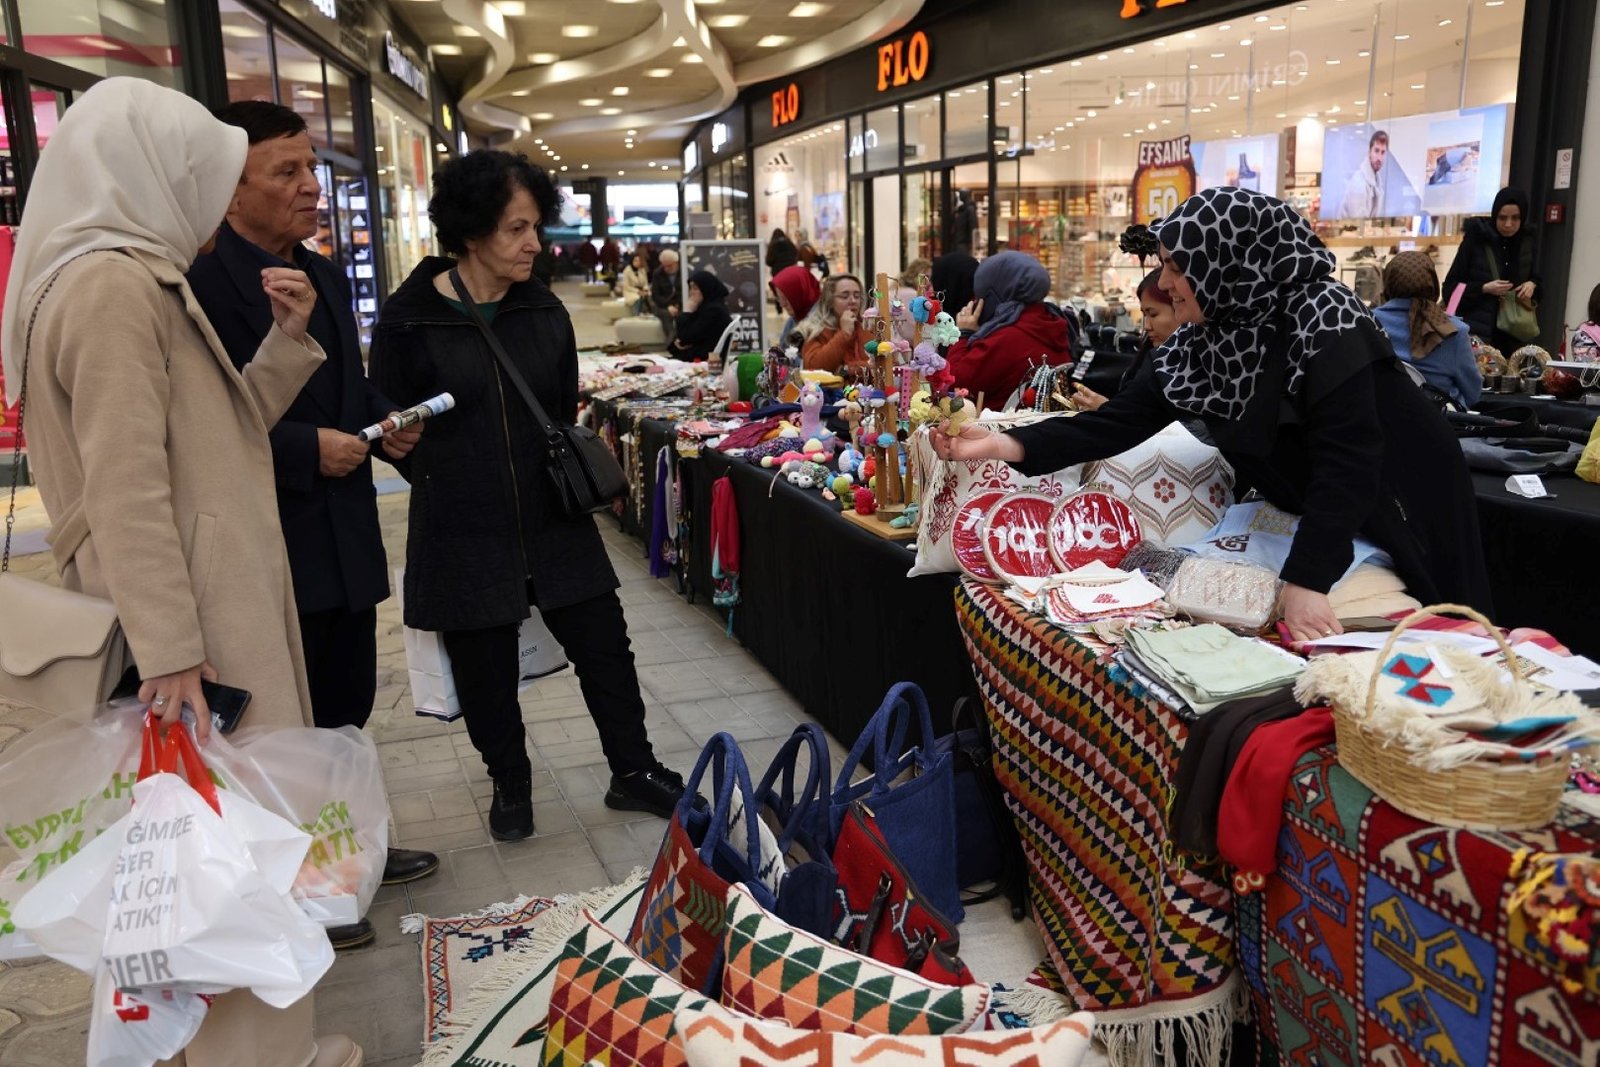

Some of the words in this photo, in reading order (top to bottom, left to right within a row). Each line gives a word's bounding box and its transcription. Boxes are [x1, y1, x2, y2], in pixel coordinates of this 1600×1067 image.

[877, 30, 928, 91] FLO
[771, 82, 799, 127] FLO
[1139, 136, 1190, 165] EFSANE
